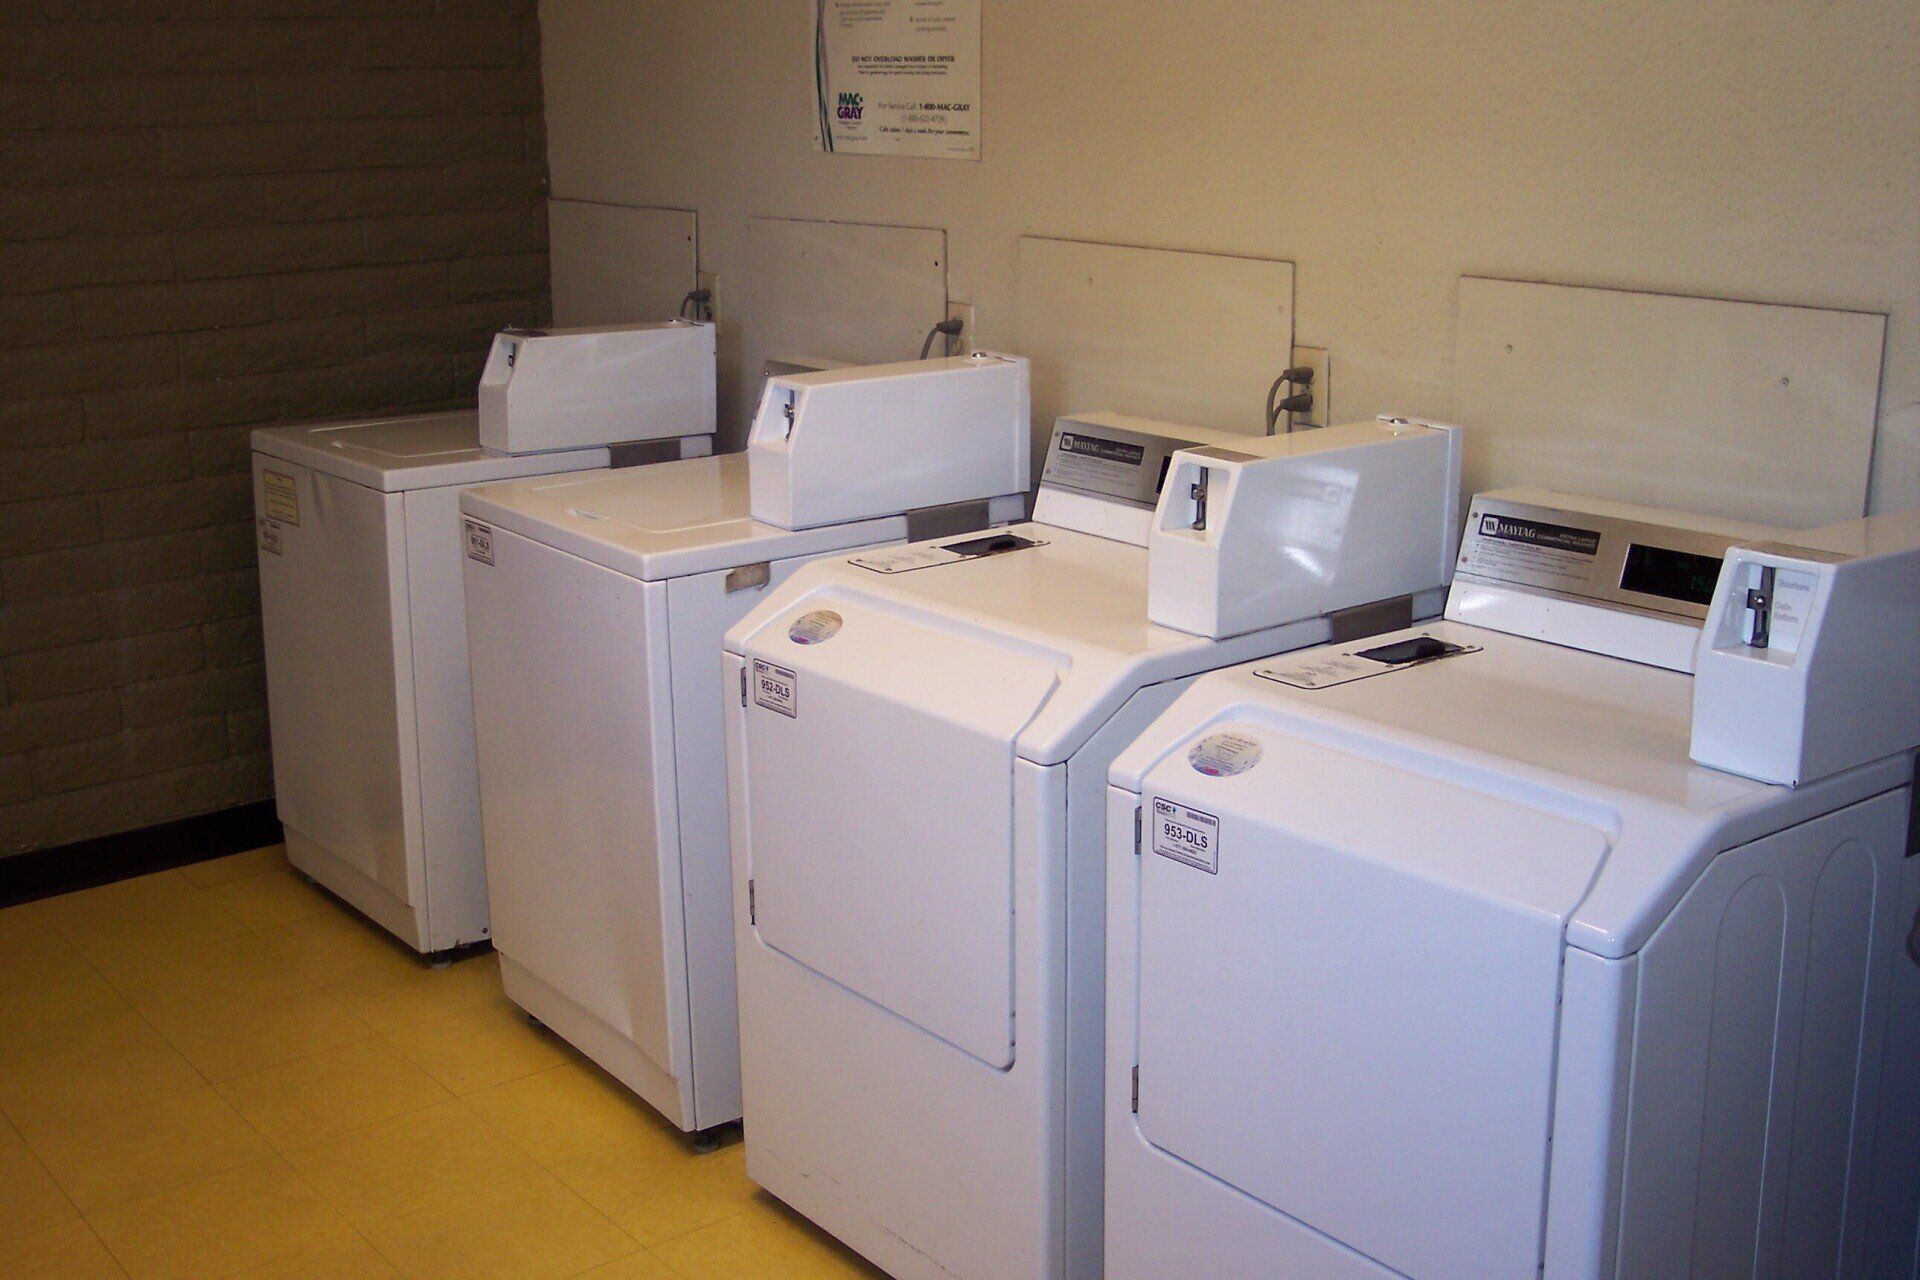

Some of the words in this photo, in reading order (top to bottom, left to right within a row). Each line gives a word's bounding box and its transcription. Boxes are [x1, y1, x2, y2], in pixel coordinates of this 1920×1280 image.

[860, 55, 872, 63] NOT
[837, 106, 864, 119] GRAY
[919, 102, 971, 112] 1-800-MAC-GRAY
[1498, 522, 1537, 539] MAYTAG
[761, 679, 790, 699] 952-DLS
[1155, 802, 1172, 813] CSC
[1164, 823, 1208, 849] 953-DLS
